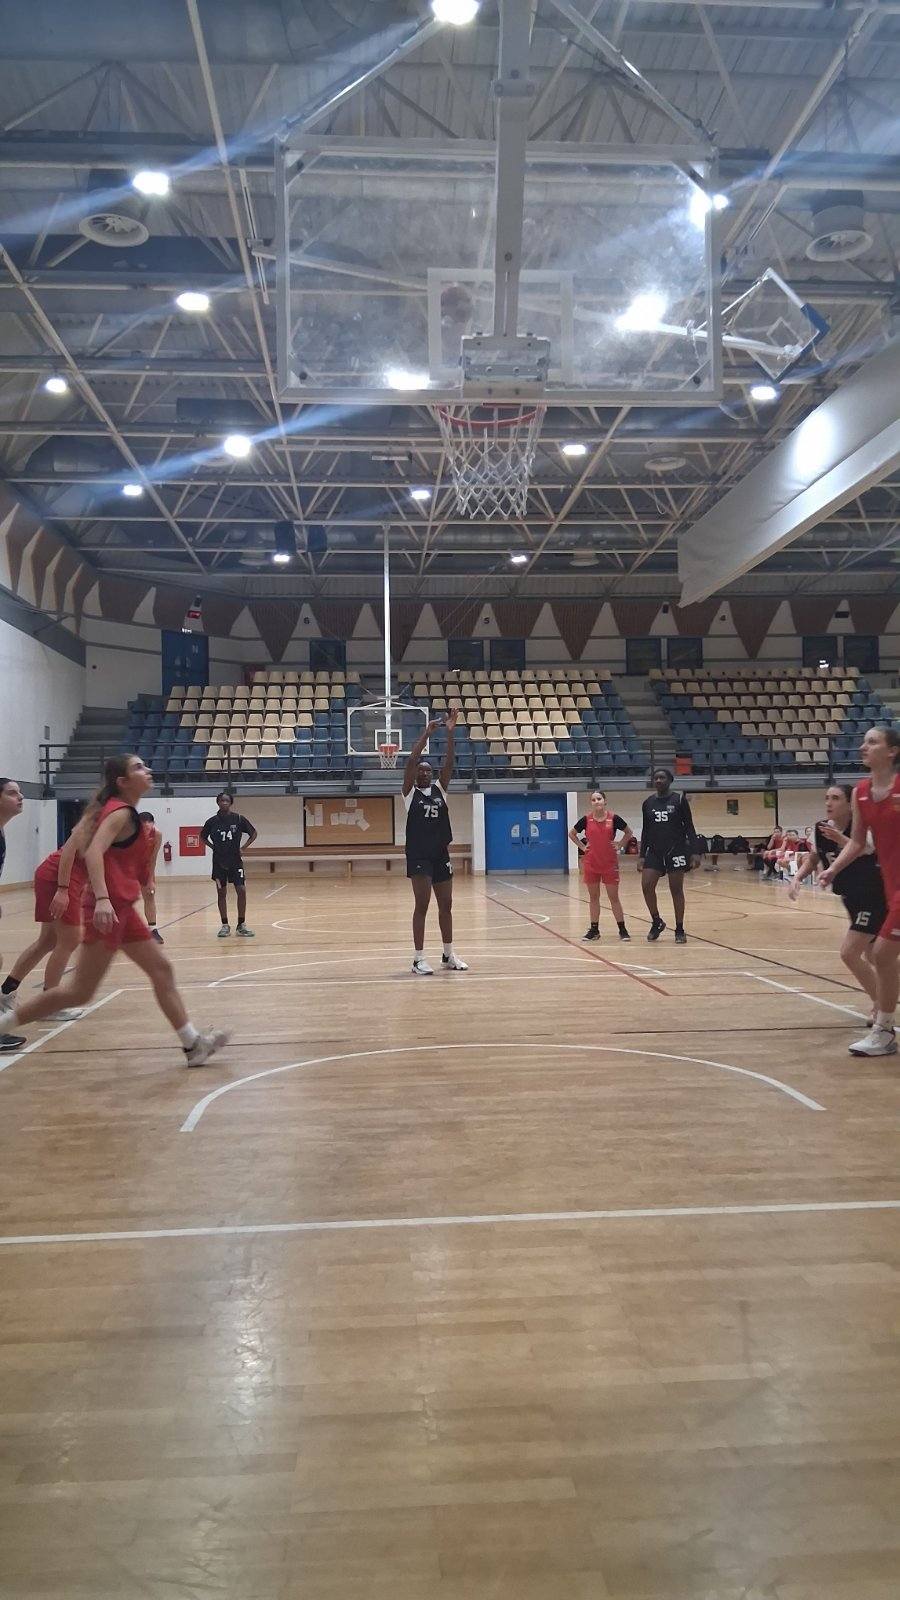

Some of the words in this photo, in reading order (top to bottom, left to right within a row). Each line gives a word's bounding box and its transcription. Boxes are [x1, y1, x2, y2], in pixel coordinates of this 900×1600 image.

[483, 617, 490, 625] 5
[423, 804, 439, 818] 75
[654, 810, 669, 823] 35
[220, 830, 233, 842] 74
[671, 855, 687, 868] 35
[855, 911, 871, 926] 15
